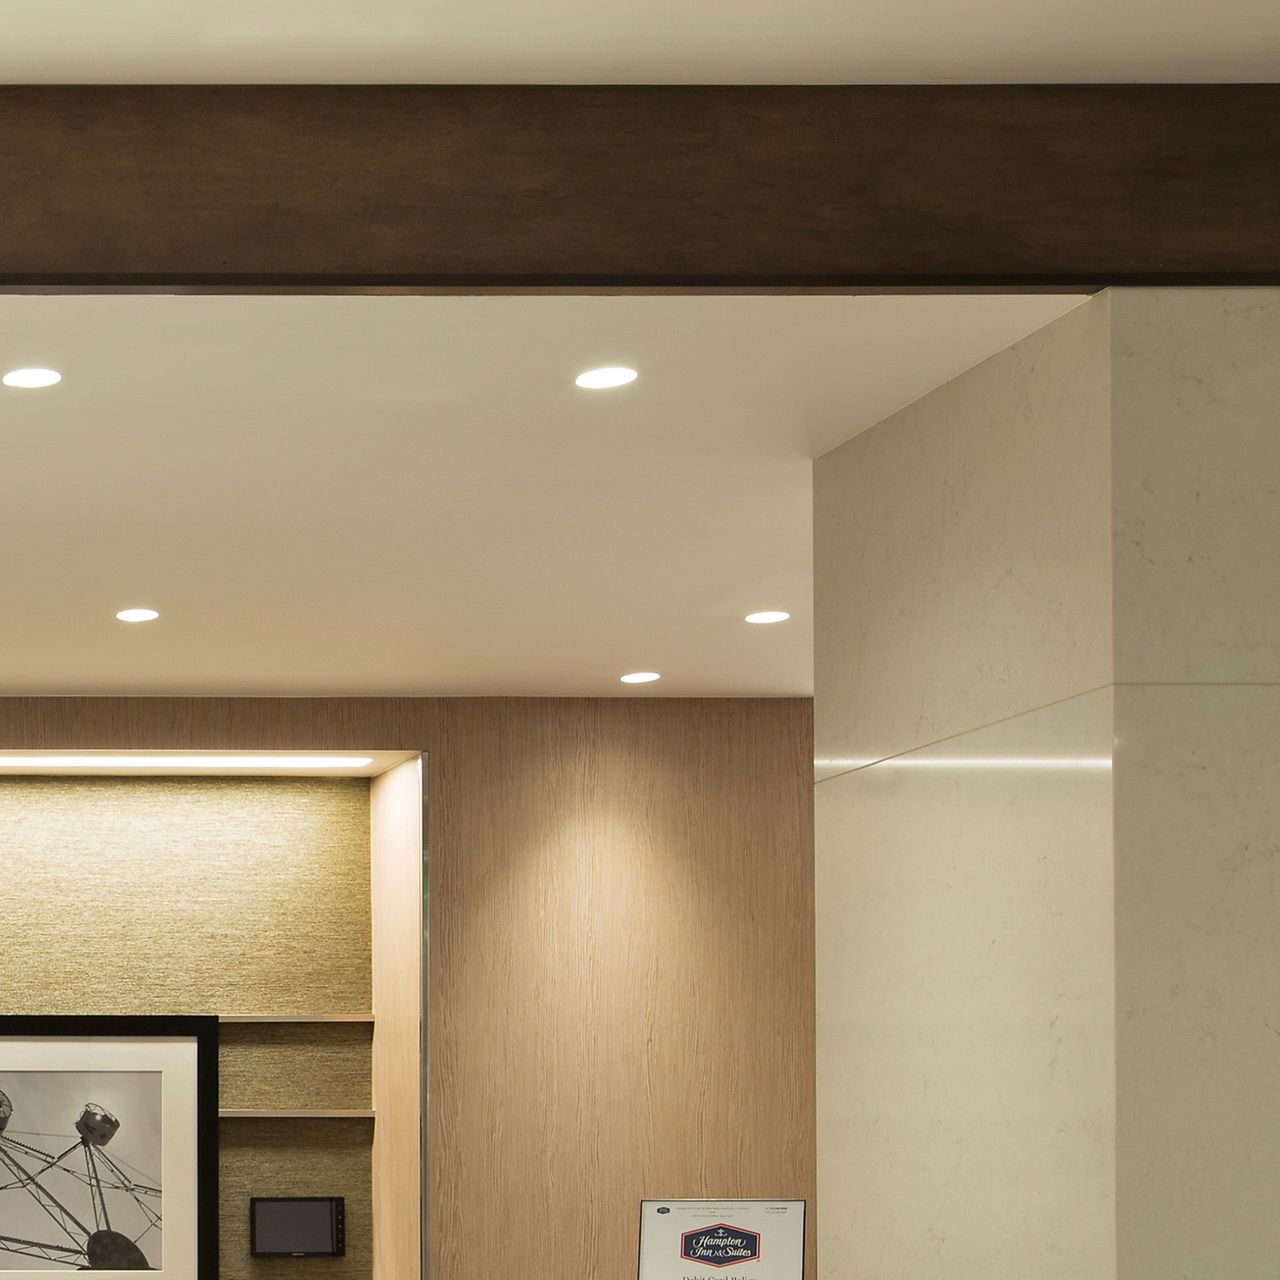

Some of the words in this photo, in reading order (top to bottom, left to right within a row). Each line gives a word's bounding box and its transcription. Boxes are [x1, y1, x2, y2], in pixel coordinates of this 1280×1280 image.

[692, 1235, 747, 1248] Hampton
[690, 1247, 716, 1257] Inn
[716, 1249, 724, 1257] &
[722, 1247, 752, 1257] Suites
